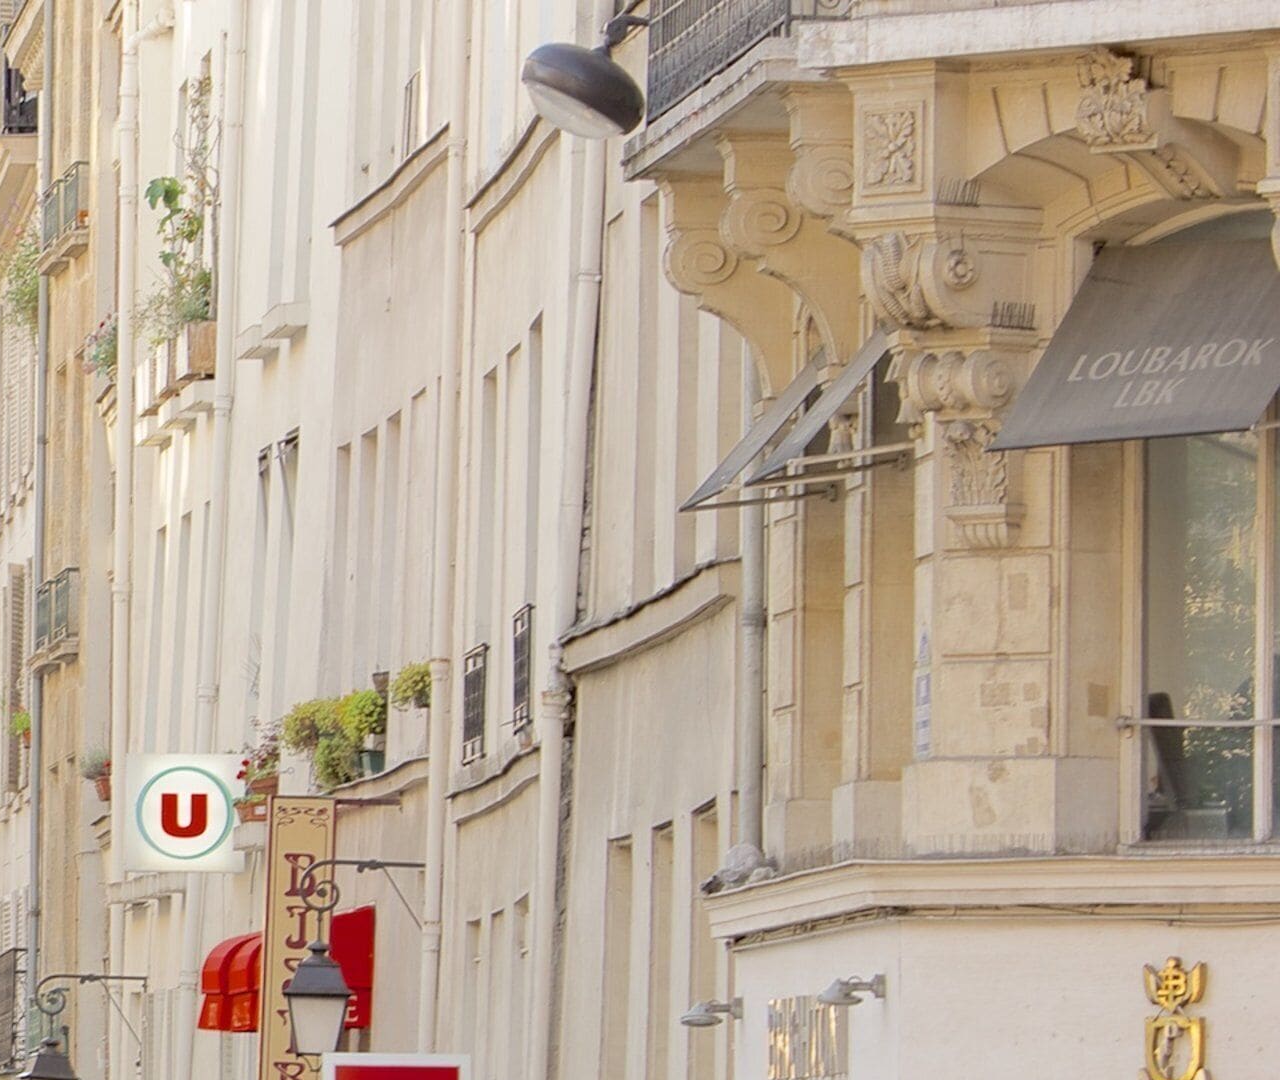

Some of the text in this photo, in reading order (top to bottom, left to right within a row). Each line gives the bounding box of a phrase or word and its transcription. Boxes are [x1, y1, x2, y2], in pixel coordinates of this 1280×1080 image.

[1067, 338, 1274, 382] LOUBAROK
[1112, 377, 1186, 408] LBK
[161, 794, 207, 838] U
